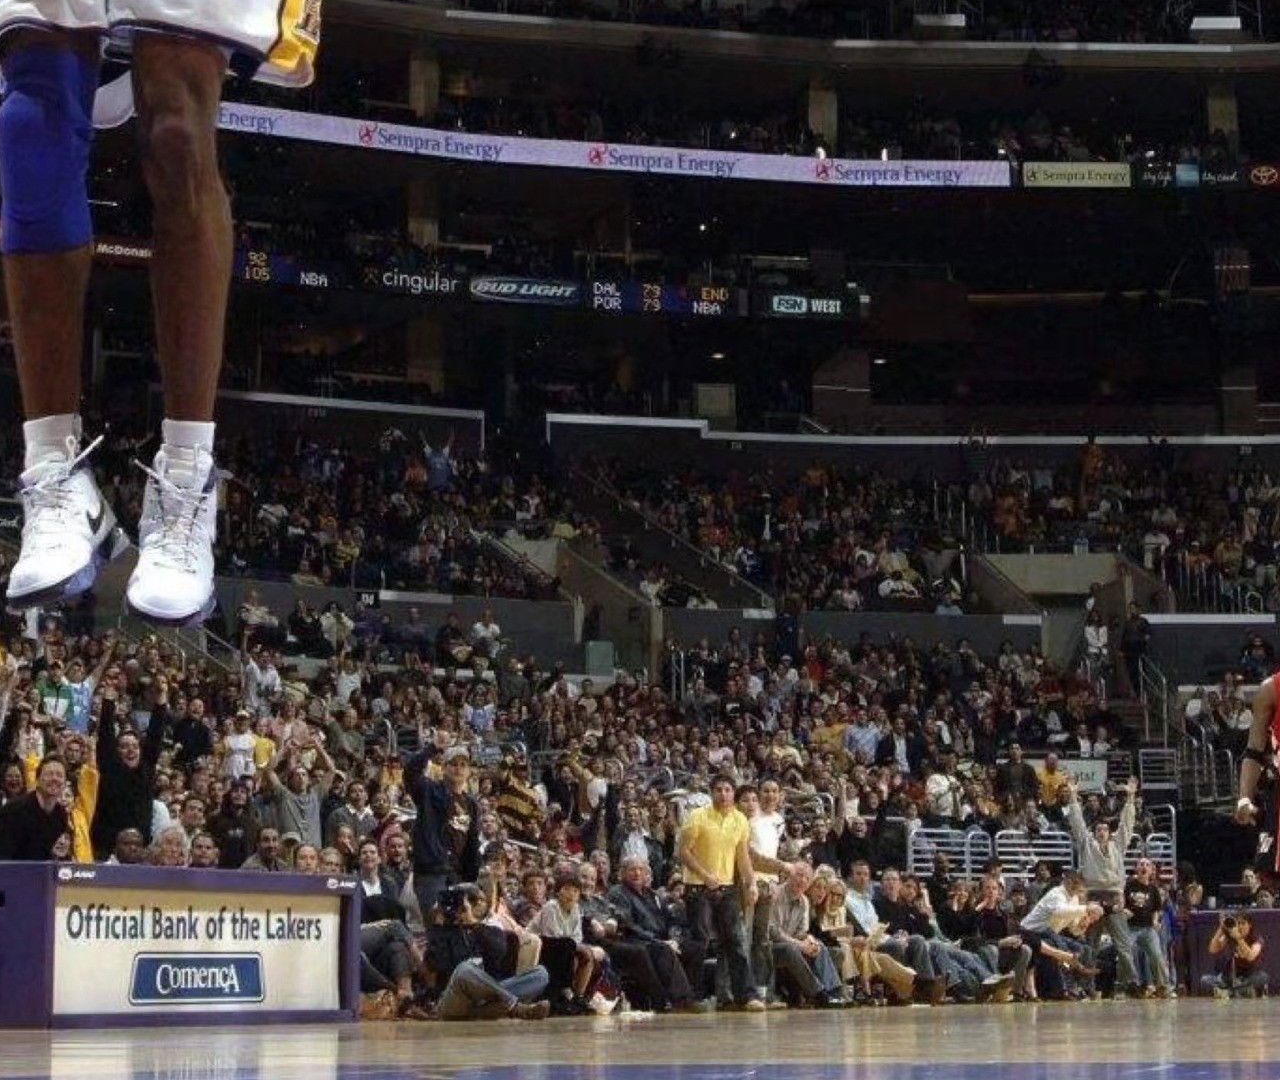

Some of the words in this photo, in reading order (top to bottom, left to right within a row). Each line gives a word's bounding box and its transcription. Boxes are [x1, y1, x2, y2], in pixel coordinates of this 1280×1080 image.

[378, 127, 441, 153] Sempra
[444, 136, 503, 160] Energy
[608, 148, 674, 171] Sempra
[677, 154, 736, 176] Energy
[834, 164, 901, 183] Sempra
[902, 166, 963, 185] Energy
[300, 272, 328, 288] NBA
[382, 267, 459, 295] cingular
[592, 281, 621, 296] DAL
[476, 281, 518, 294] BUD
[520, 283, 577, 298] LIGHT
[701, 286, 729, 301] END
[592, 296, 622, 310] POR
[810, 298, 842, 313] WEST
[66, 904, 146, 940] Official
[151, 905, 199, 940] Bank
[205, 904, 227, 940] of
[230, 906, 261, 941] the
[265, 907, 322, 941] Lakers
